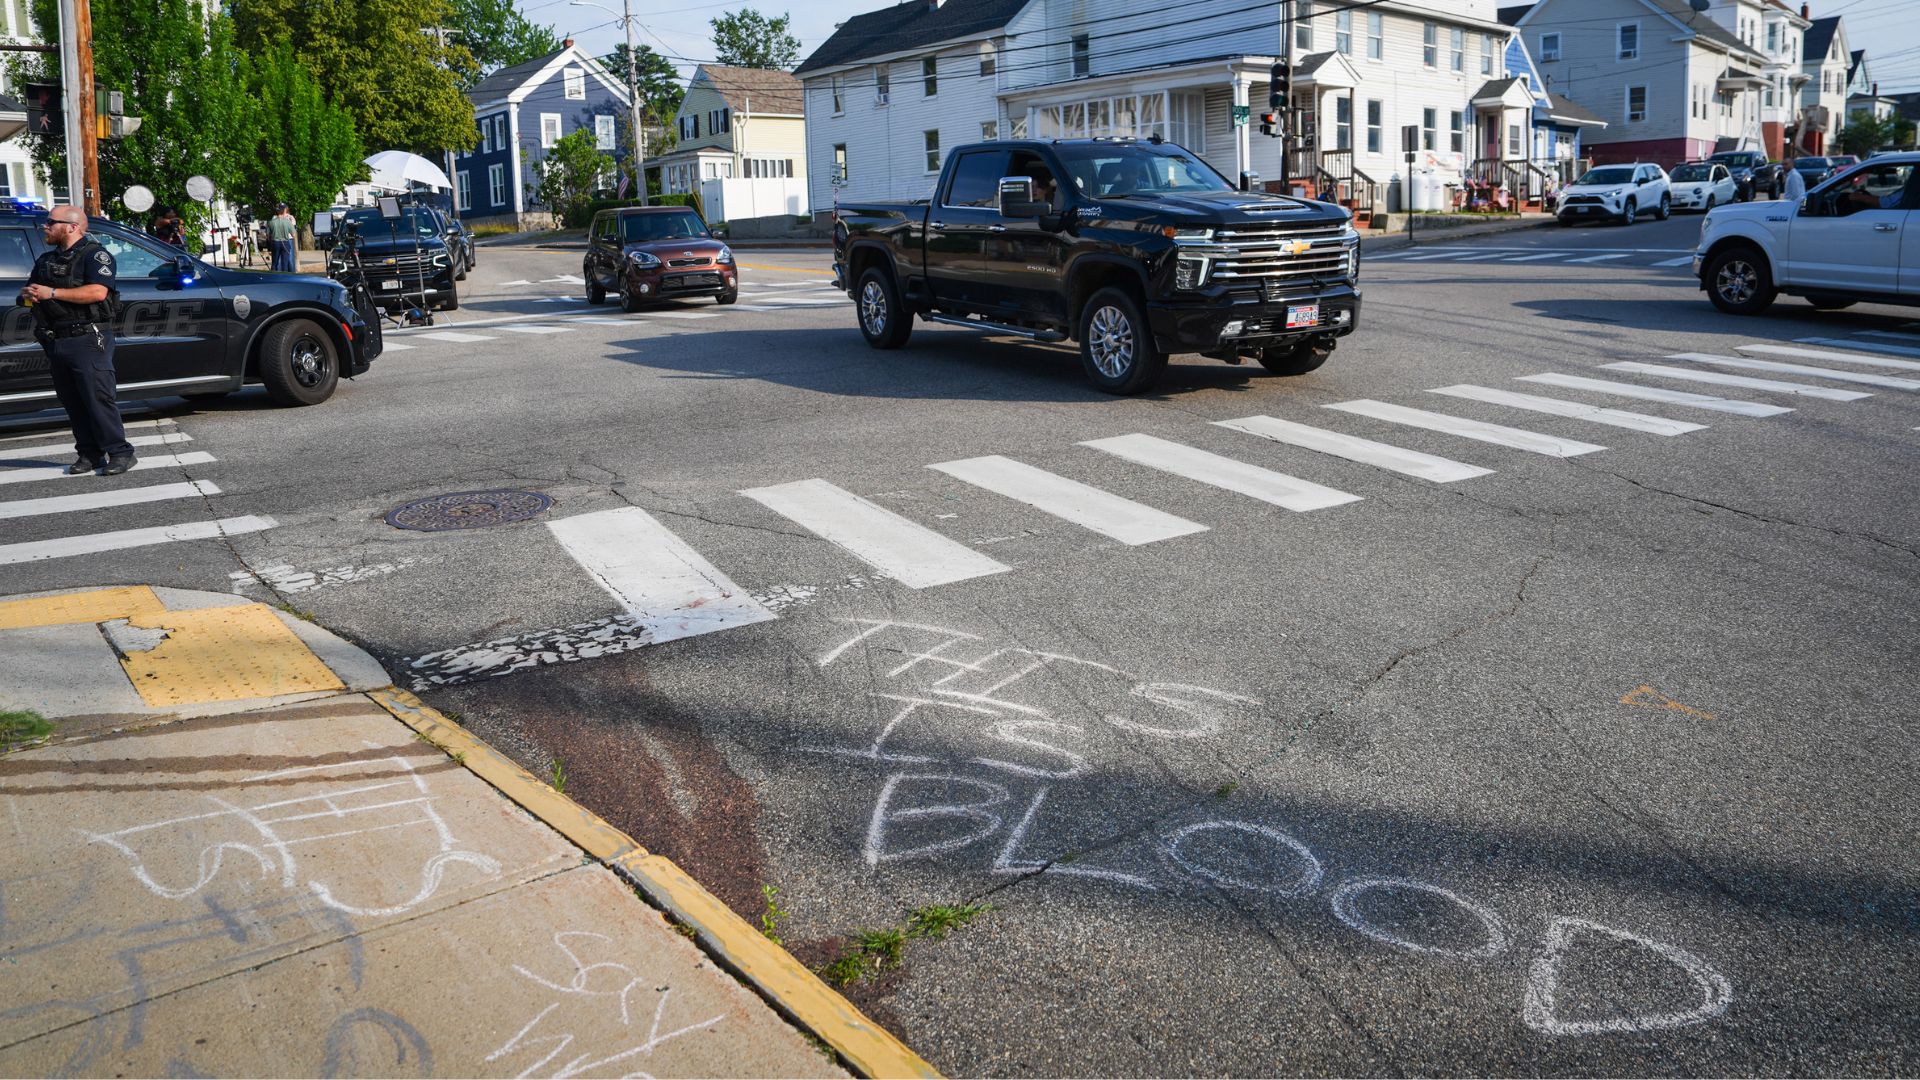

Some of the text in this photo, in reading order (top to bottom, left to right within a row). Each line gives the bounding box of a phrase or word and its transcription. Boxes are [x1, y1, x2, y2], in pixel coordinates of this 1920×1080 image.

[831, 175, 842, 185] 25
[0, 300, 204, 346] OCE
[817, 615, 1264, 738] THIS
[780, 692, 1091, 779] IS
[864, 770, 1734, 1037] BLOOD
